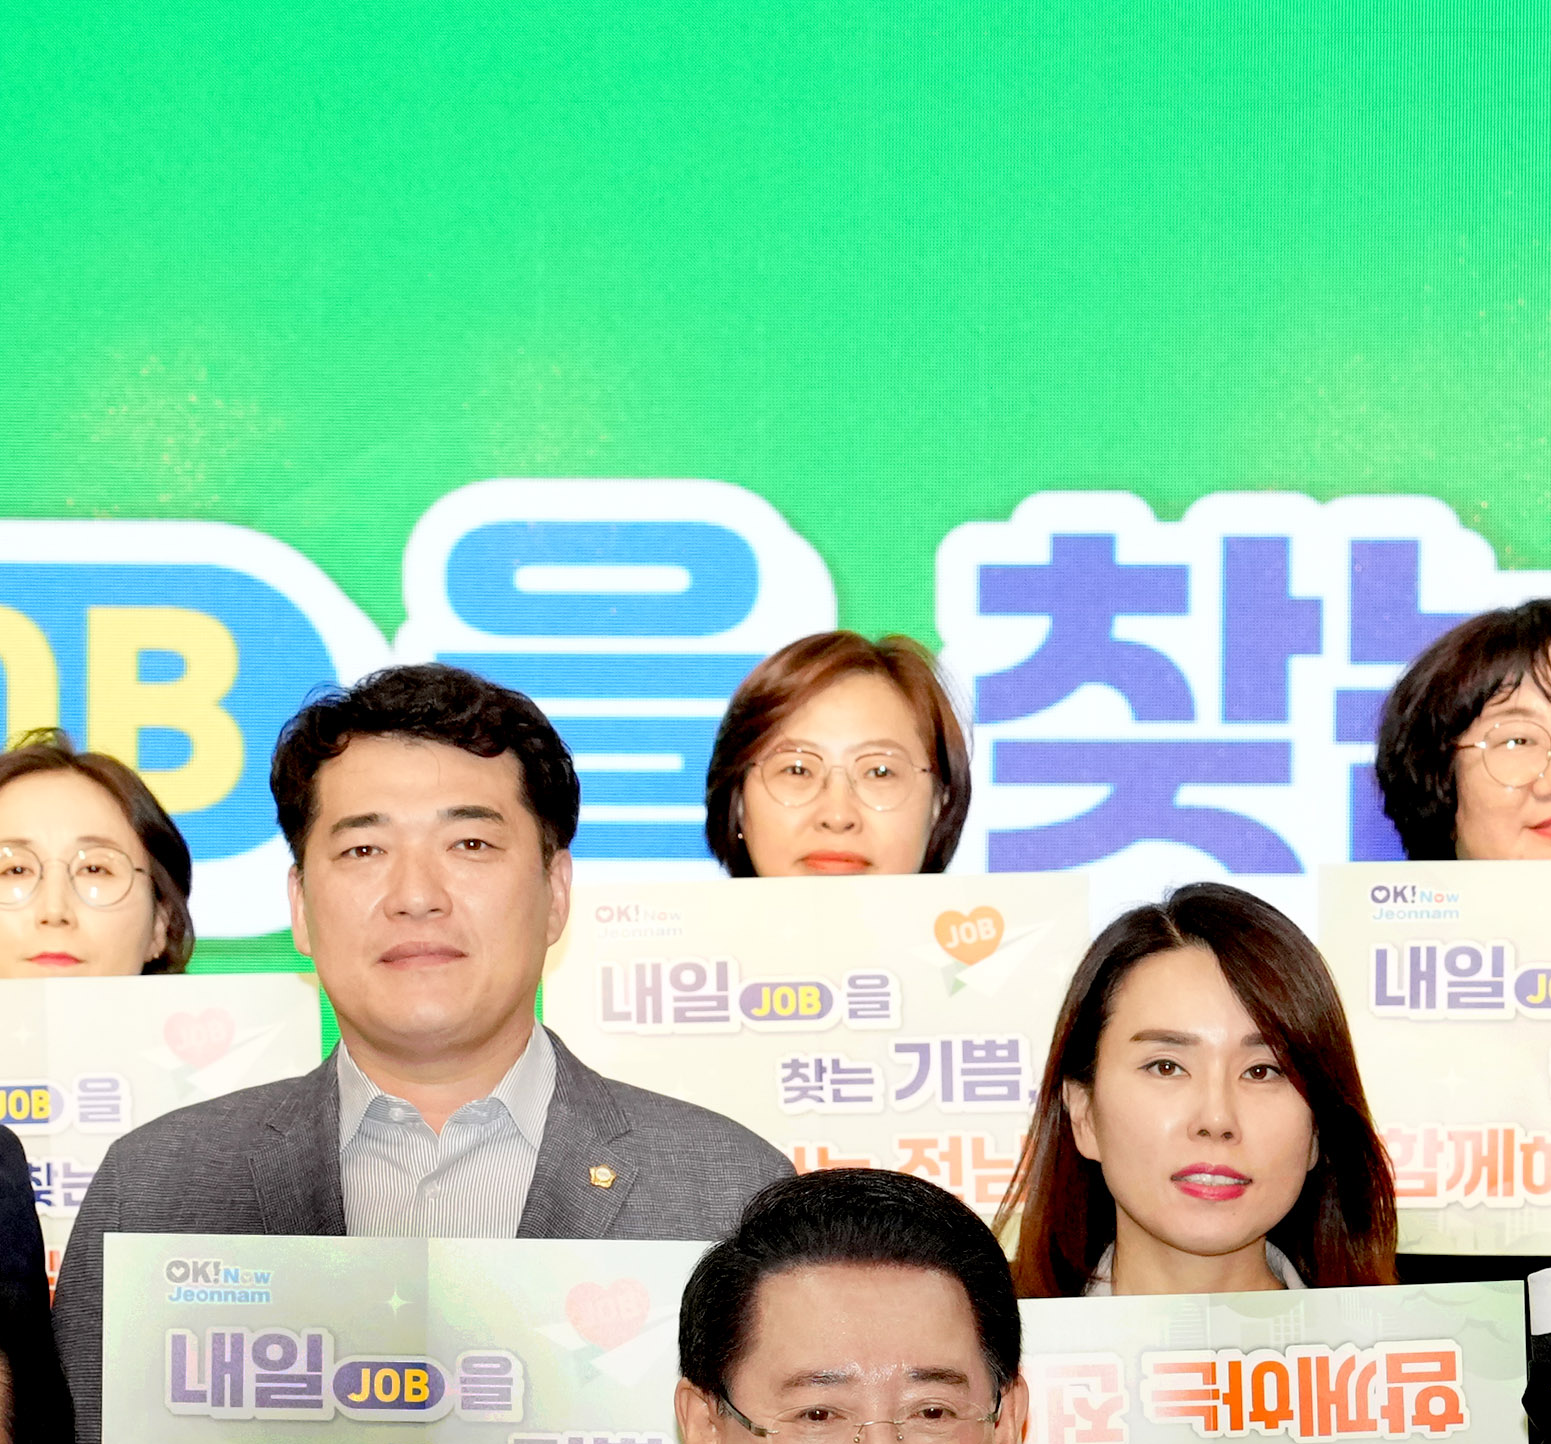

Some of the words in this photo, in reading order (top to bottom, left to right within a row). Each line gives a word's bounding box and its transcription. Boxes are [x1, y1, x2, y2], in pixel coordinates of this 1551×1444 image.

[595, 904, 639, 923] OK!
[1371, 886, 1416, 904] OK!
[1420, 891, 1459, 903] Now
[1373, 907, 1459, 920] Jeonnam
[946, 917, 997, 948] JOB
[602, 962, 730, 1024] 내일
[751, 987, 822, 1016] JOB
[846, 974, 891, 1019] 을
[1375, 946, 1505, 1010] 내일
[781, 1059, 874, 1104] 찾는
[78, 1078, 121, 1124] 을
[166, 1260, 220, 1285] OK!
[223, 1267, 271, 1284] Now
[168, 1286, 271, 1304] Jeonnam
[170, 1332, 323, 1410] 내일
[349, 1367, 430, 1403] JOB
[460, 1355, 513, 1411] 을
[1150, 1350, 1464, 1438] 함께하는
